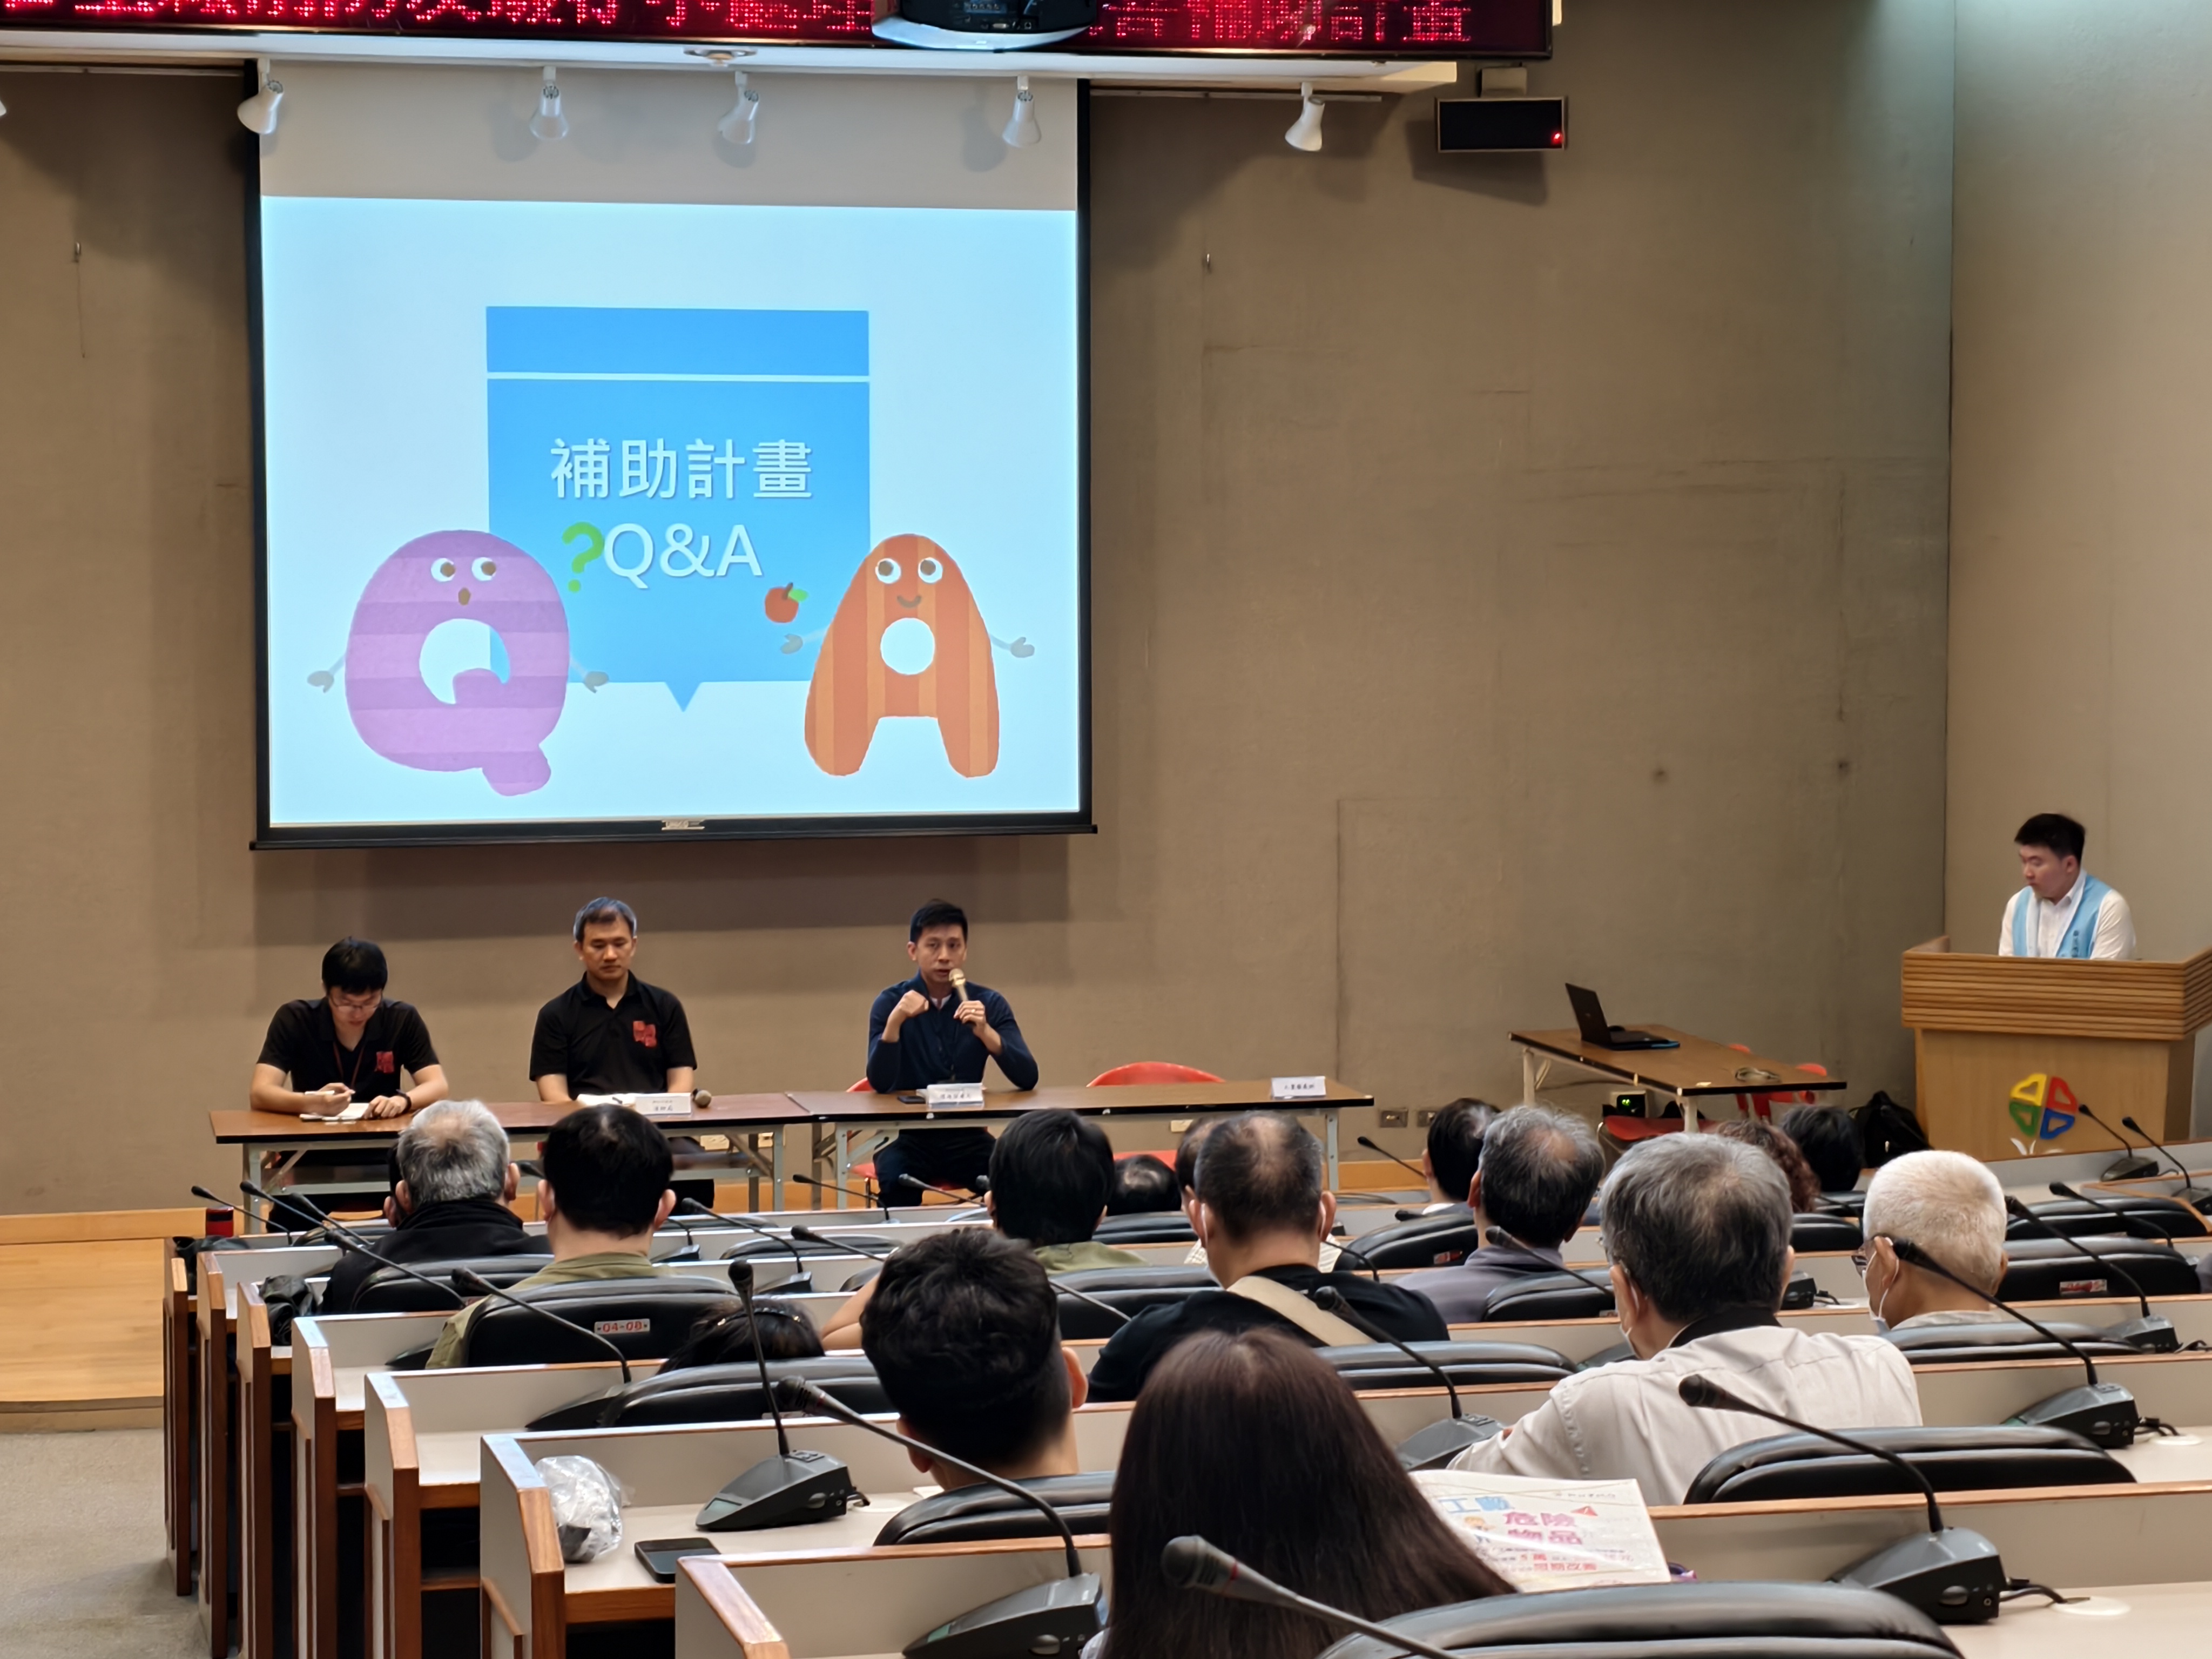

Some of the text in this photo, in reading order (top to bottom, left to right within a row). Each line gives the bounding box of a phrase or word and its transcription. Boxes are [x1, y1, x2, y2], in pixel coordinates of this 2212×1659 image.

[551, 438, 812, 499] 補助計畫
[604, 523, 763, 590] Q&A
